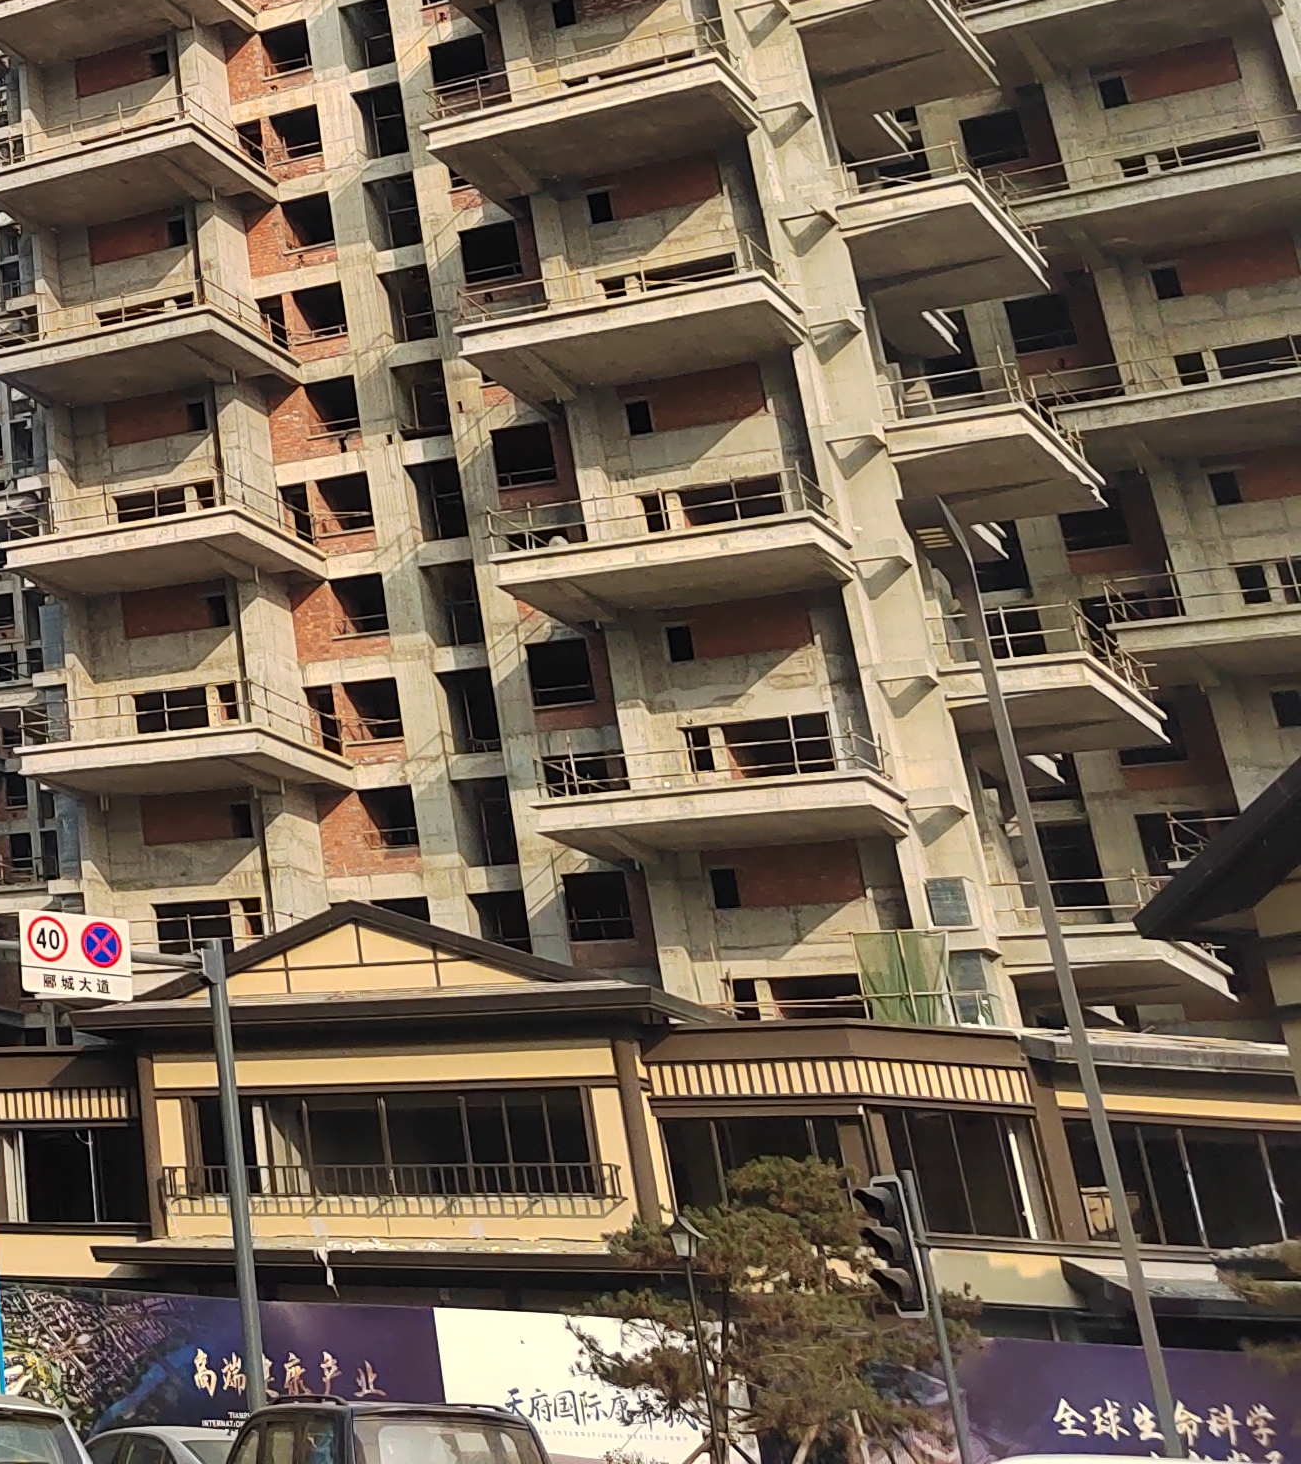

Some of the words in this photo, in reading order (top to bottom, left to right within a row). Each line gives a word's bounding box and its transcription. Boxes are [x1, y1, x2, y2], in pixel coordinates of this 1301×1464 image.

[36, 927, 60, 950] 40
[1052, 1397, 1277, 1447] 全球生命科学
